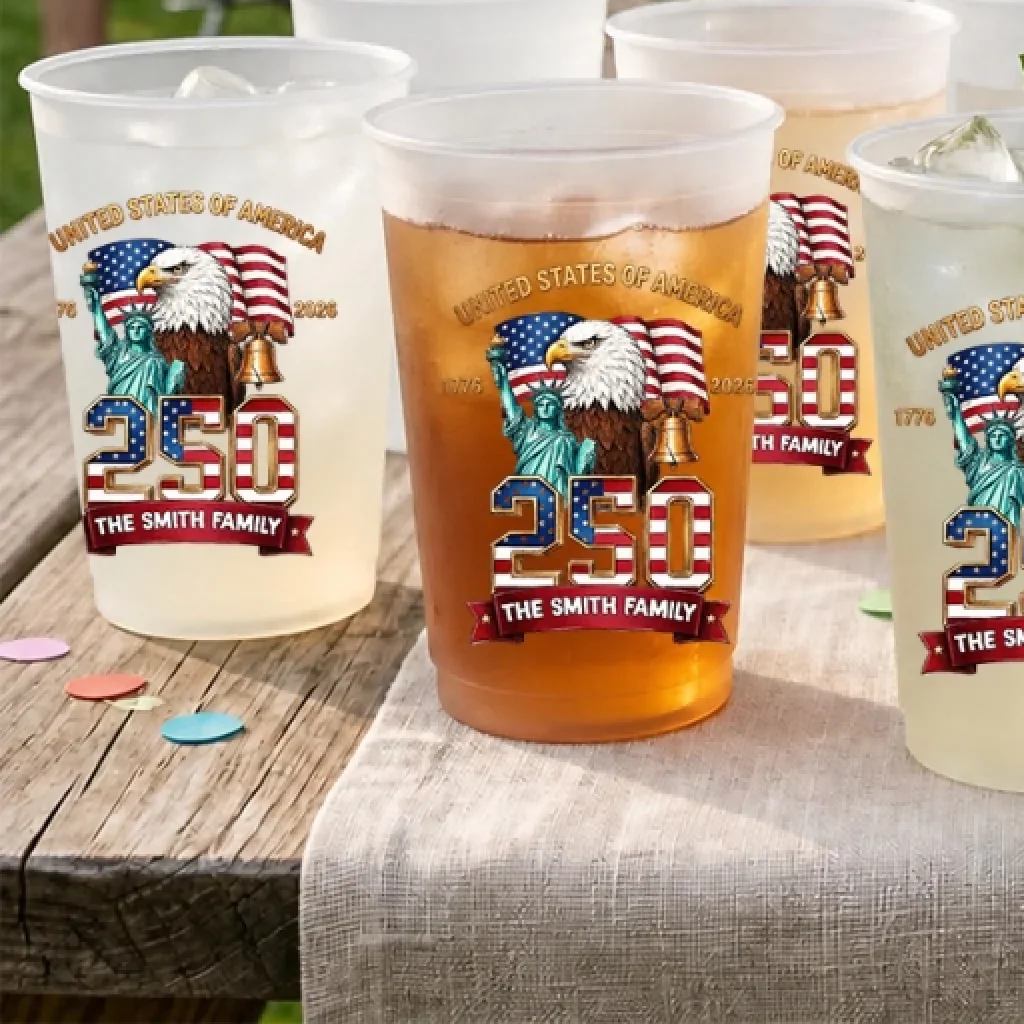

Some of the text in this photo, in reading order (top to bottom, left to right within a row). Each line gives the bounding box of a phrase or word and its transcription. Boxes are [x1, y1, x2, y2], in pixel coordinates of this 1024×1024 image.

[778, 148, 804, 170] OF
[48, 190, 327, 255] UNITED STATES OF AMERICA
[57, 301, 77, 318] 76
[453, 263, 743, 328] UNITED STATES OF AMERICA
[904, 306, 986, 358] UNITED
[754, 330, 858, 432] 50
[82, 394, 299, 507] 250
[781, 434, 844, 457] FAMILY
[94, 509, 283, 536] THE SMITH FAMILY
[491, 475, 714, 592] 250
[501, 595, 697, 623] THE SMITH FAMILY
[954, 629, 997, 653] THE
